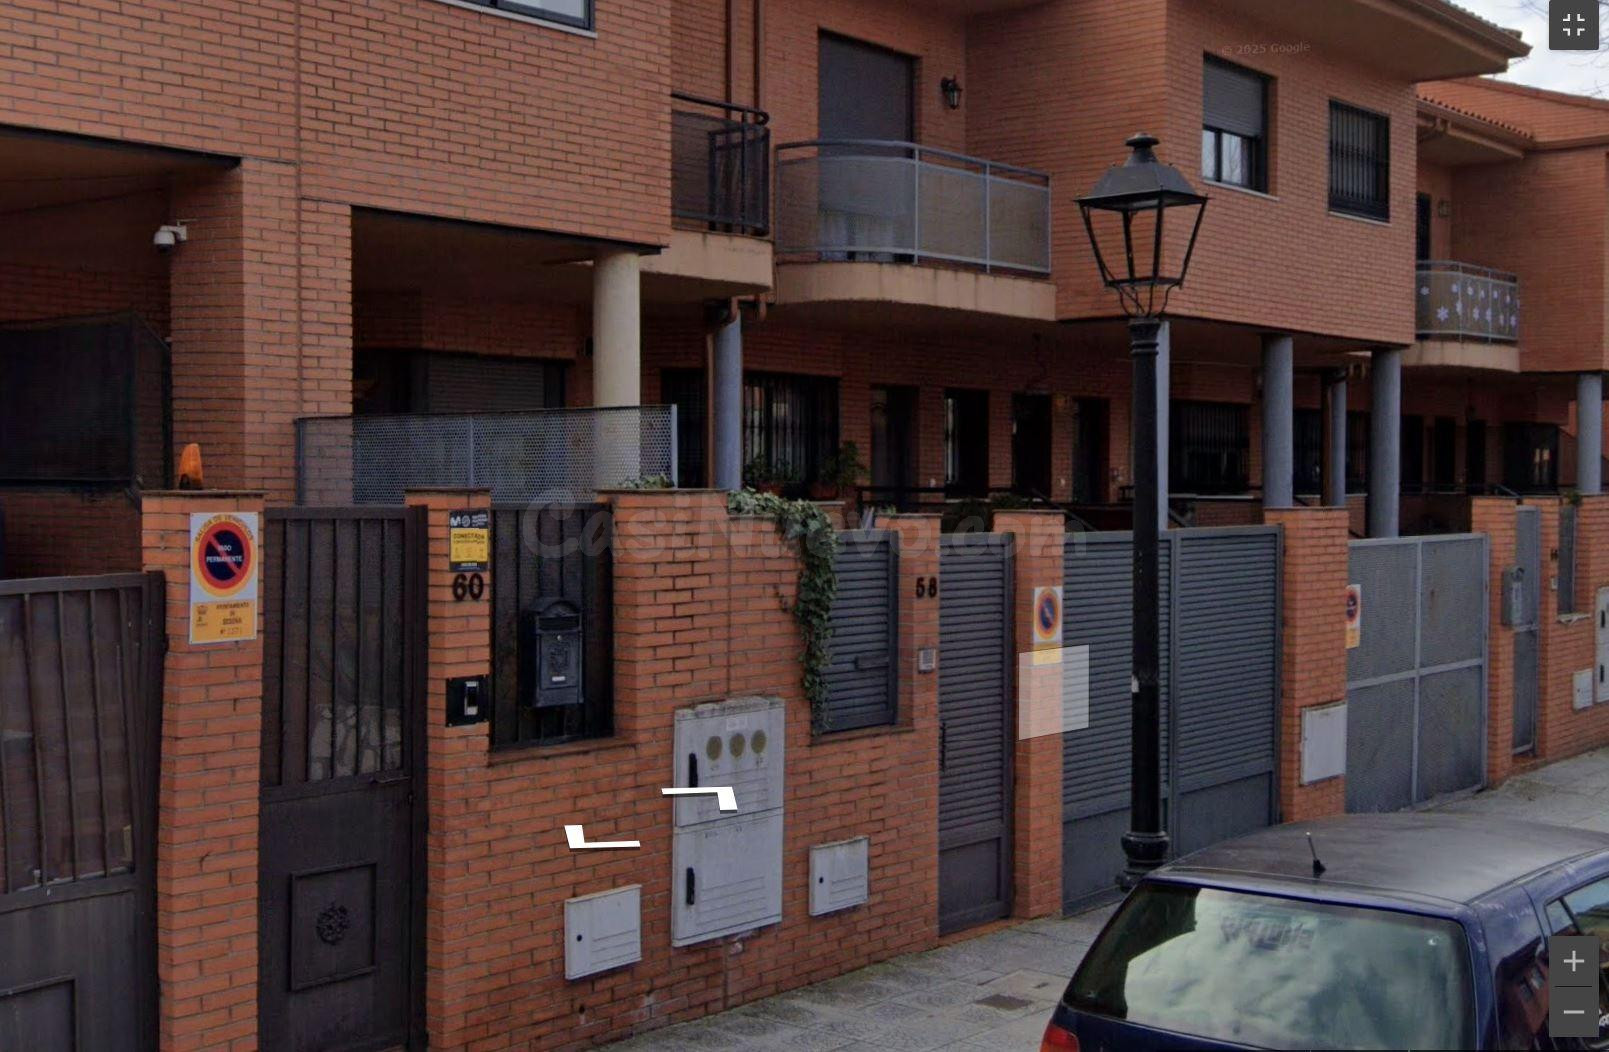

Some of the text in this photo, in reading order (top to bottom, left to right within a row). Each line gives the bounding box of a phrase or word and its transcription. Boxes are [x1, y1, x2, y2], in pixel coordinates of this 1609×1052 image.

[206, 555, 243, 563] PERMANENTE
[453, 573, 484, 601] 60
[915, 577, 938, 598] 58
